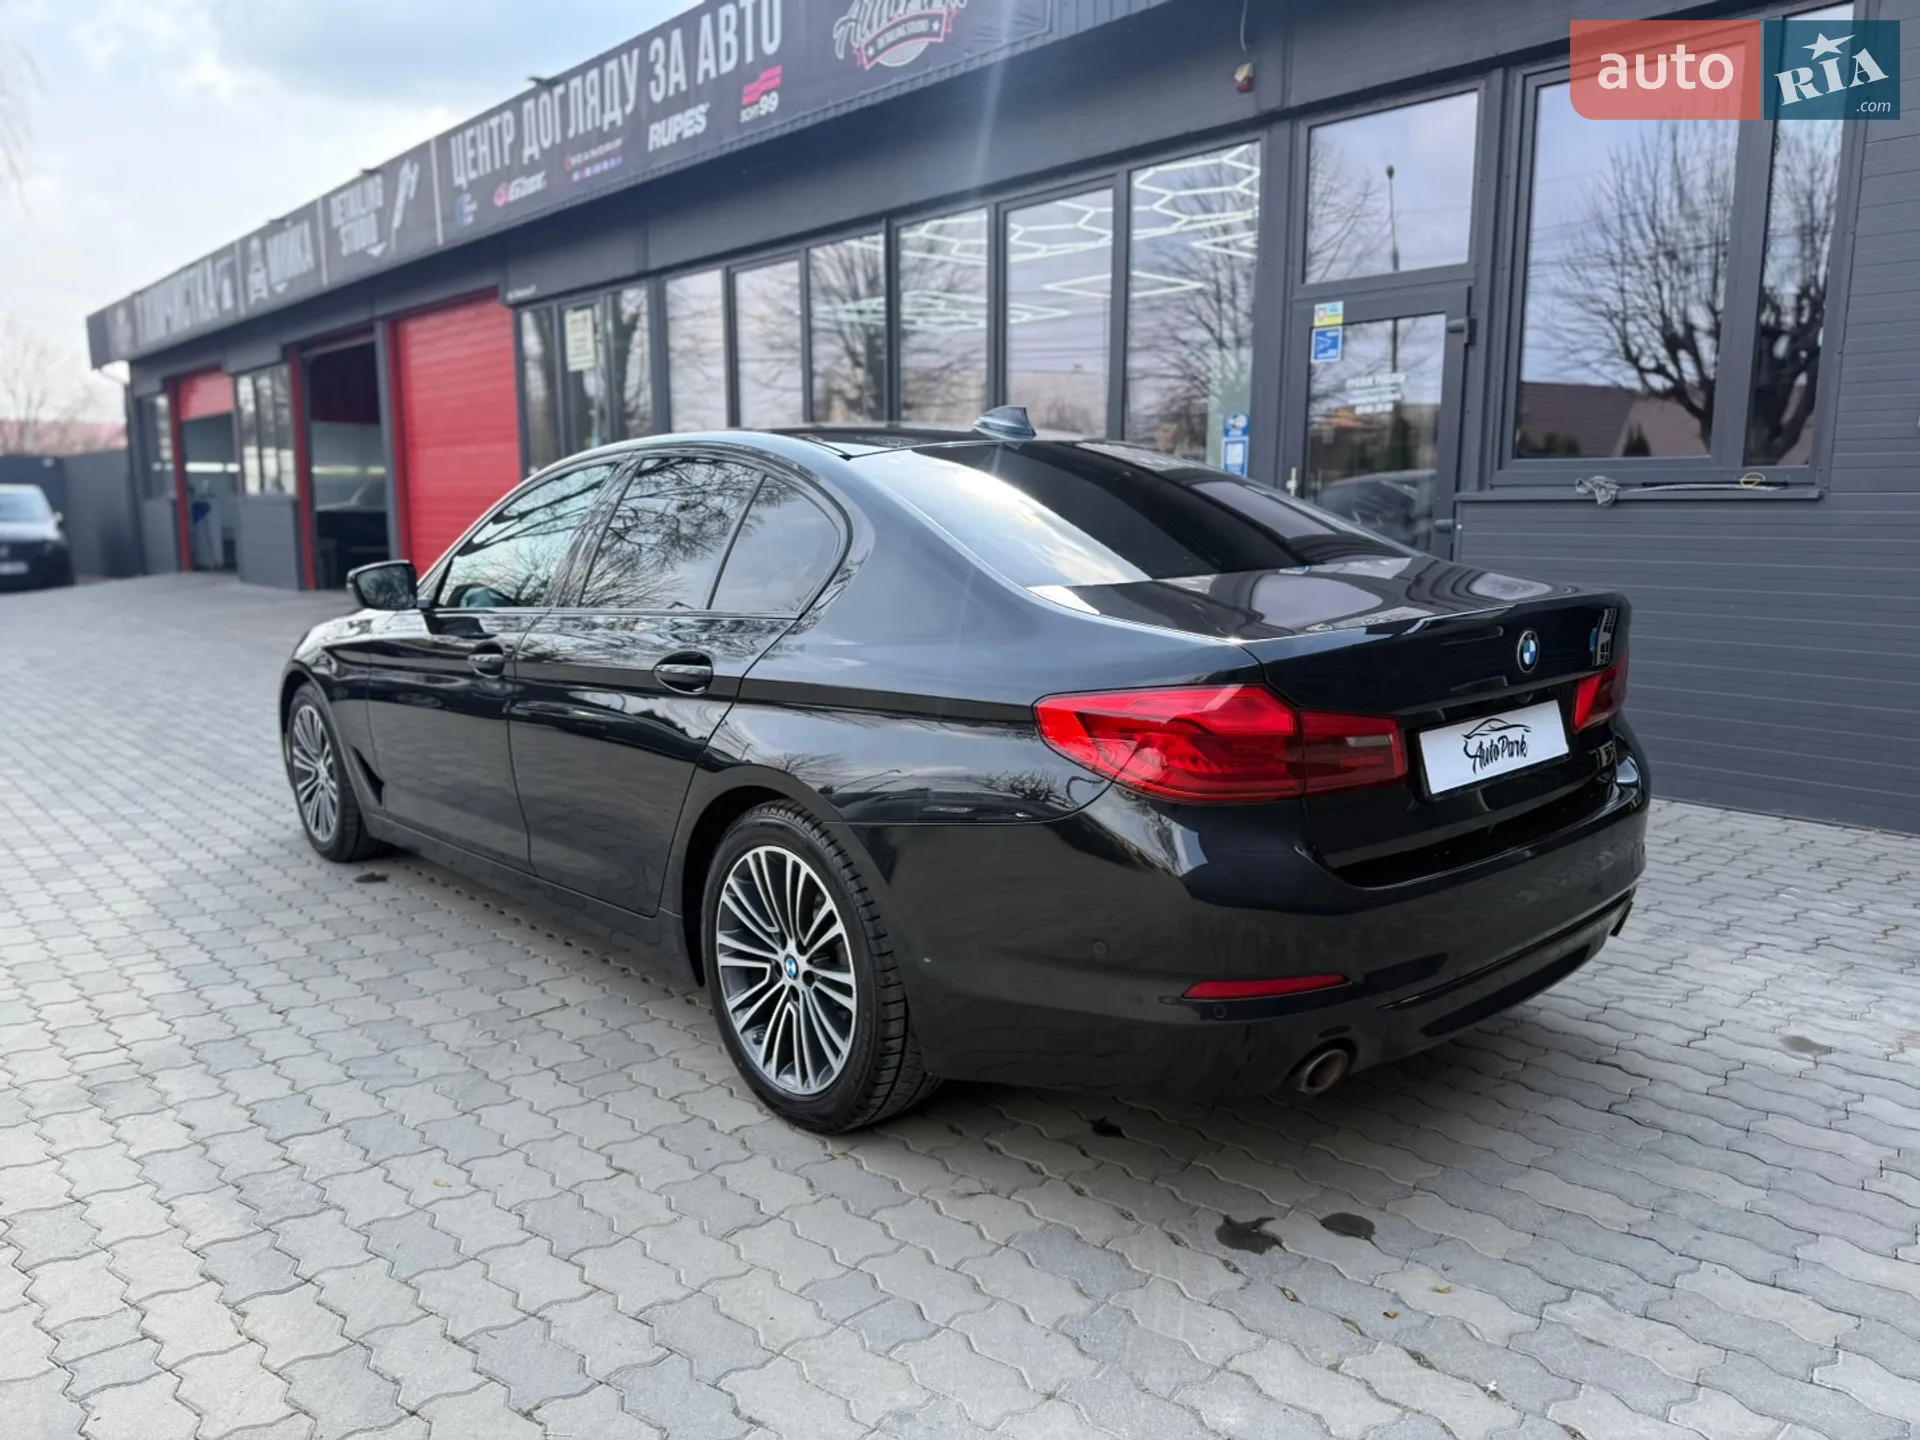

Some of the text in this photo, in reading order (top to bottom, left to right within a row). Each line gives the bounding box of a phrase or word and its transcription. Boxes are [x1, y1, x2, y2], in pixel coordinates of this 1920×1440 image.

[451, 112, 515, 188] ЦЕНТР
[521, 48, 640, 166] ДОГЛЯДУ
[648, 28, 688, 103] ЗА
[697, 0, 782, 84] АВТО
[648, 102, 708, 152] RUPES
